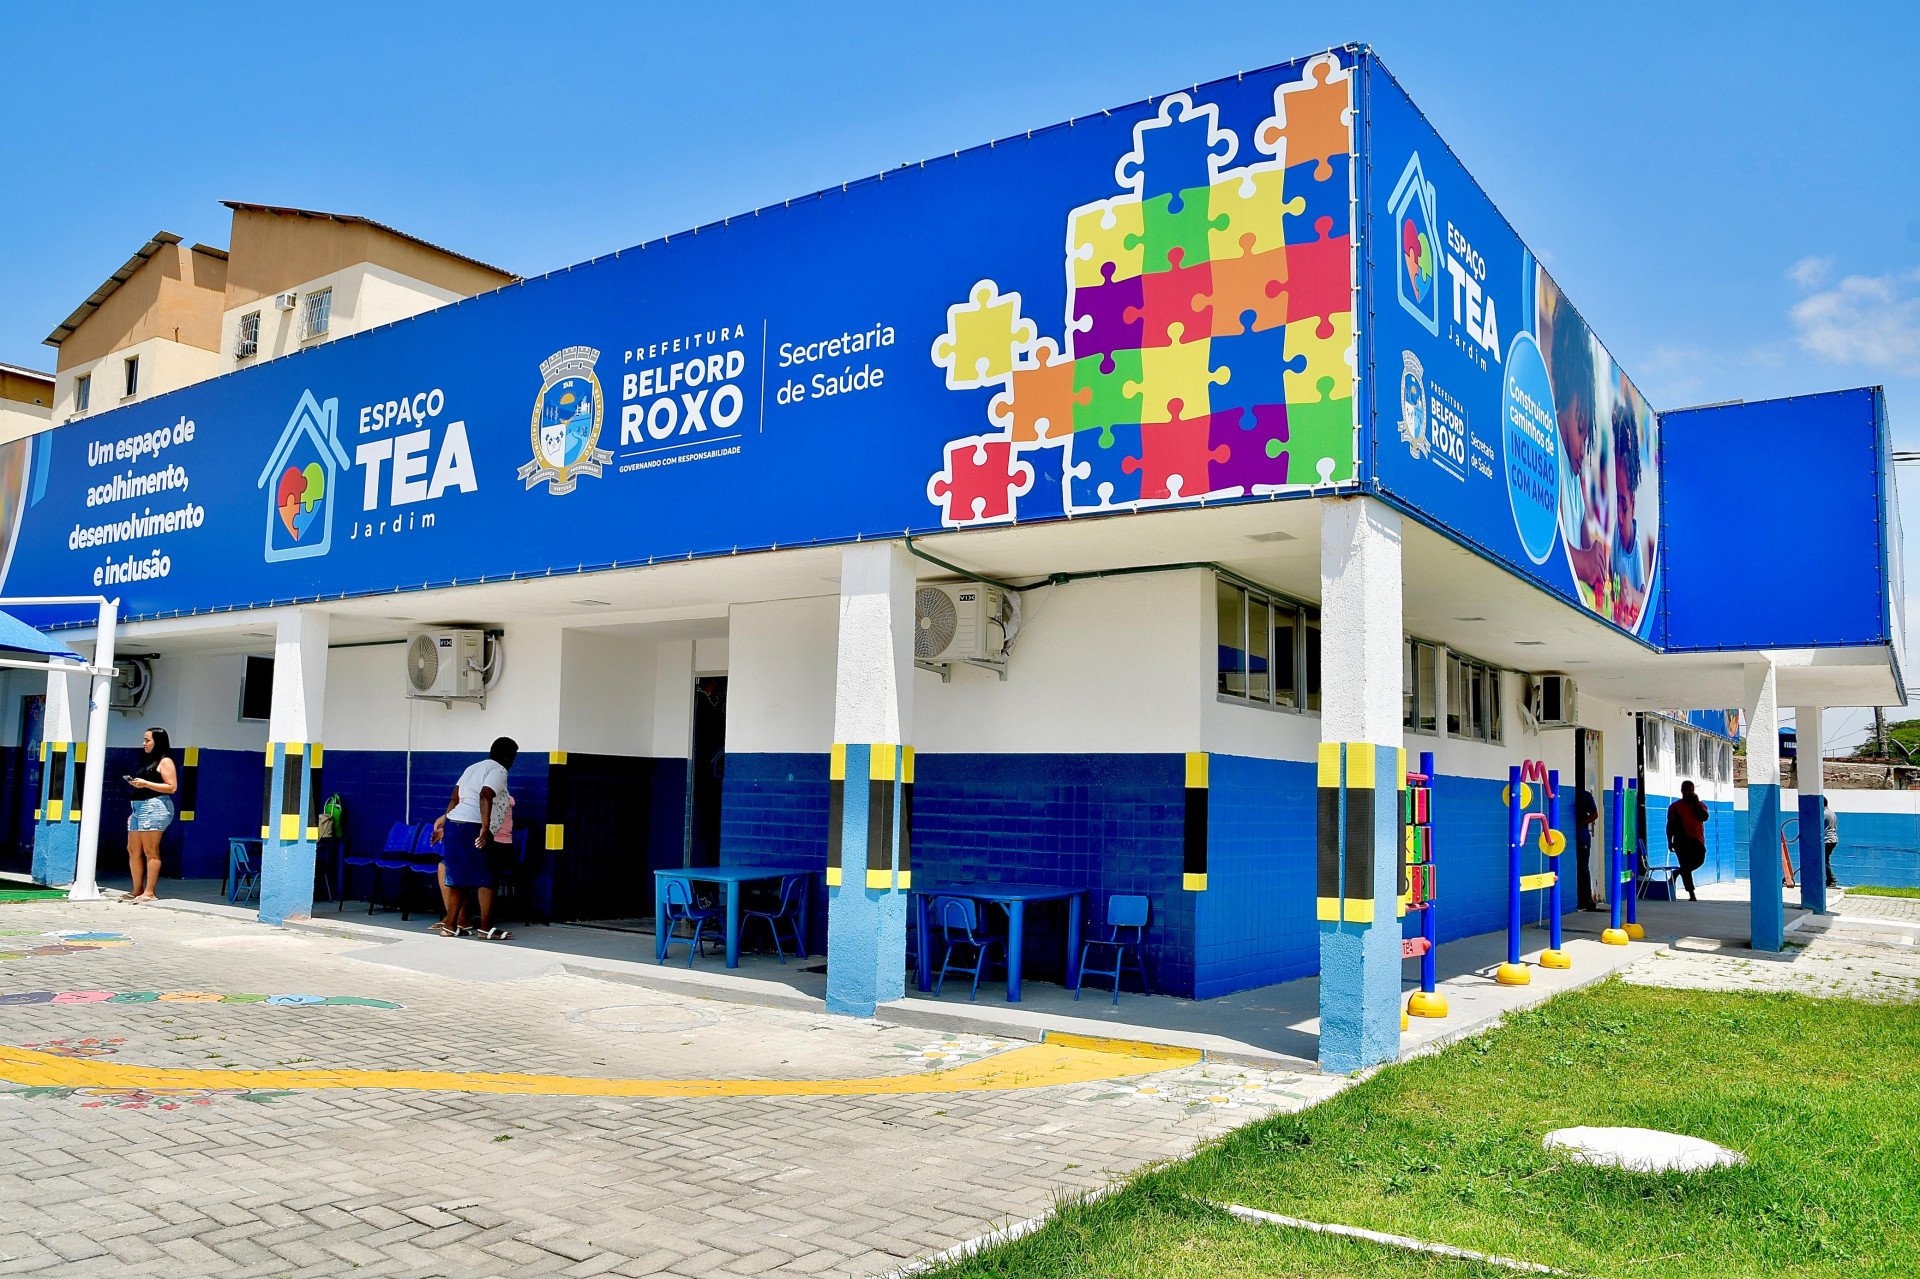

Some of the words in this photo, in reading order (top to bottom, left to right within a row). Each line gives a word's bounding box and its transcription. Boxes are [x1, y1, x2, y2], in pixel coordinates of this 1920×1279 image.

[1447, 221, 1486, 281] ESPAÇO
[1447, 253, 1502, 364] TEA
[625, 324, 745, 363] PREFEITURA
[779, 322, 895, 367] Secretaria
[1448, 325, 1487, 372] Jardim
[623, 350, 745, 401] BELFORD
[777, 379, 805, 405] de
[811, 364, 884, 399] Saúde
[1430, 380, 1464, 414] PREFEITURA
[359, 389, 444, 434] ESPAÇO
[620, 384, 744, 446] ROXO
[1431, 396, 1464, 437] BELFORD
[1509, 376, 1553, 434] Construindo
[88, 440, 114, 467] Um
[115, 428, 172, 464] espaço
[173, 416, 196, 445] de
[1431, 417, 1465, 465] ROXO
[1470, 431, 1495, 461] Secretaria
[1509, 405, 1545, 449] caminhos
[1545, 432, 1554, 457] de
[356, 420, 479, 512] TEA
[619, 459, 661, 473] GOVERNANDO
[662, 456, 677, 466] COM
[678, 445, 741, 464] RESPONSABILIDADE
[1478, 457, 1493, 480] Saúde
[1510, 430, 1555, 487] INCLUSÃO
[87, 463, 189, 508] acolhimento,
[1511, 463, 1531, 498] COM
[1532, 483, 1555, 515] AMOR
[69, 502, 205, 551] desenvolvimento
[350, 511, 436, 540] Jardim
[93, 566, 104, 587] e
[105, 549, 171, 585] inclusão
